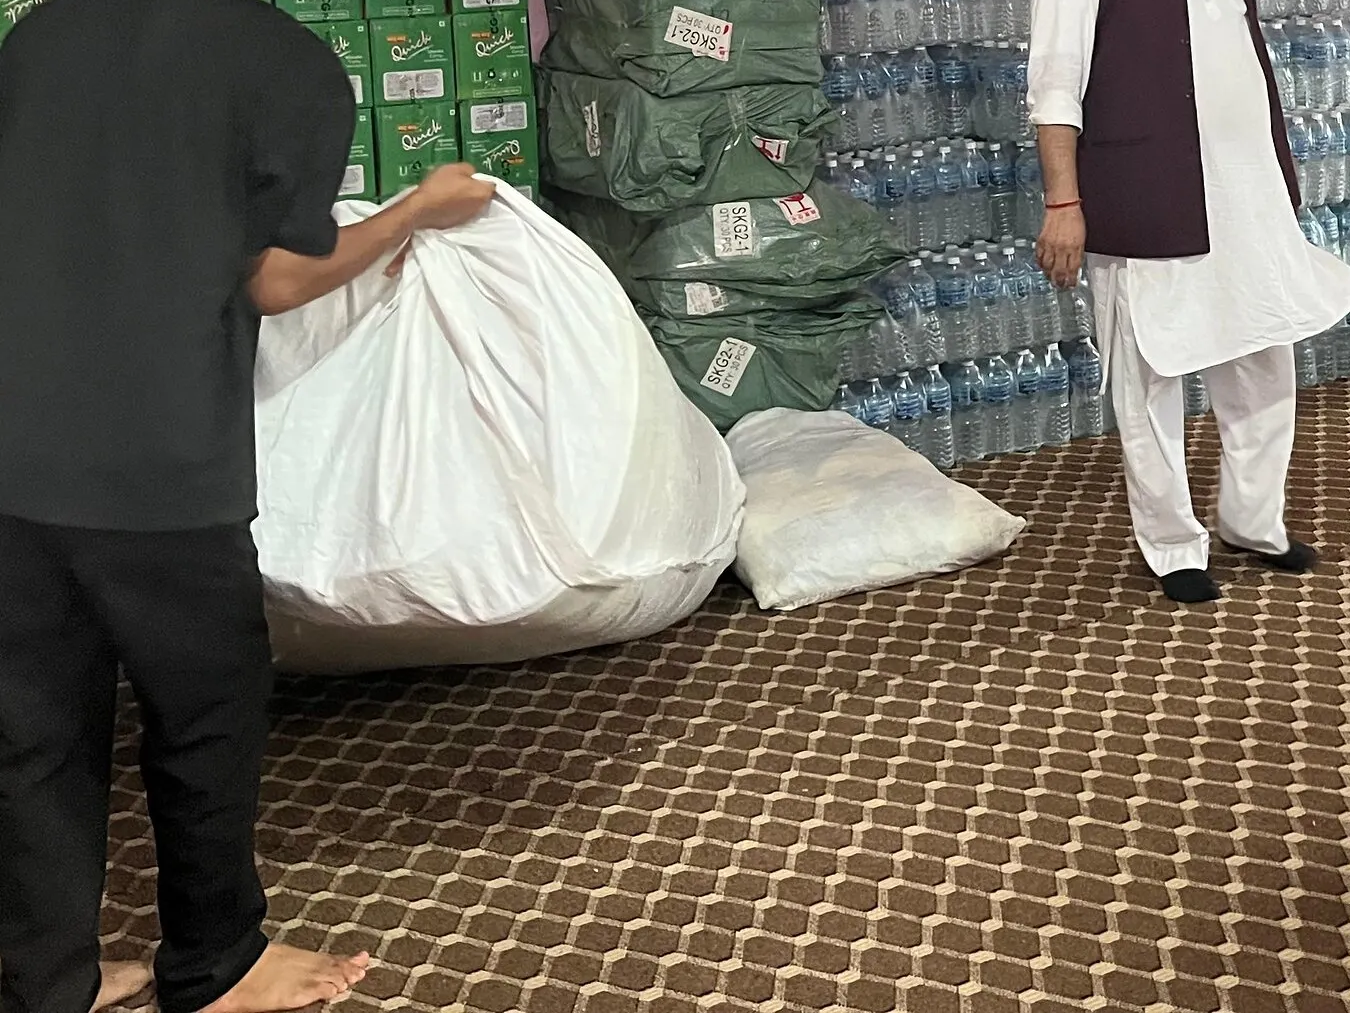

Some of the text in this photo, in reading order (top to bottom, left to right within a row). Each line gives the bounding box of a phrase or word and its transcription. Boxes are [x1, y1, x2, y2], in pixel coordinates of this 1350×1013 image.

[677, 13, 694, 25] PCS
[705, 22, 722, 35] QTY
[391, 30, 432, 62] Quick
[475, 27, 515, 58] Quick
[671, 25, 719, 51] SKG2-1
[401, 119, 443, 151] Quick
[719, 207, 729, 221] QTY
[732, 206, 747, 256] SKG2-1
[706, 339, 739, 385] SKG2-1
[722, 374, 735, 389] QTY
[736, 343, 749, 361] PCS
